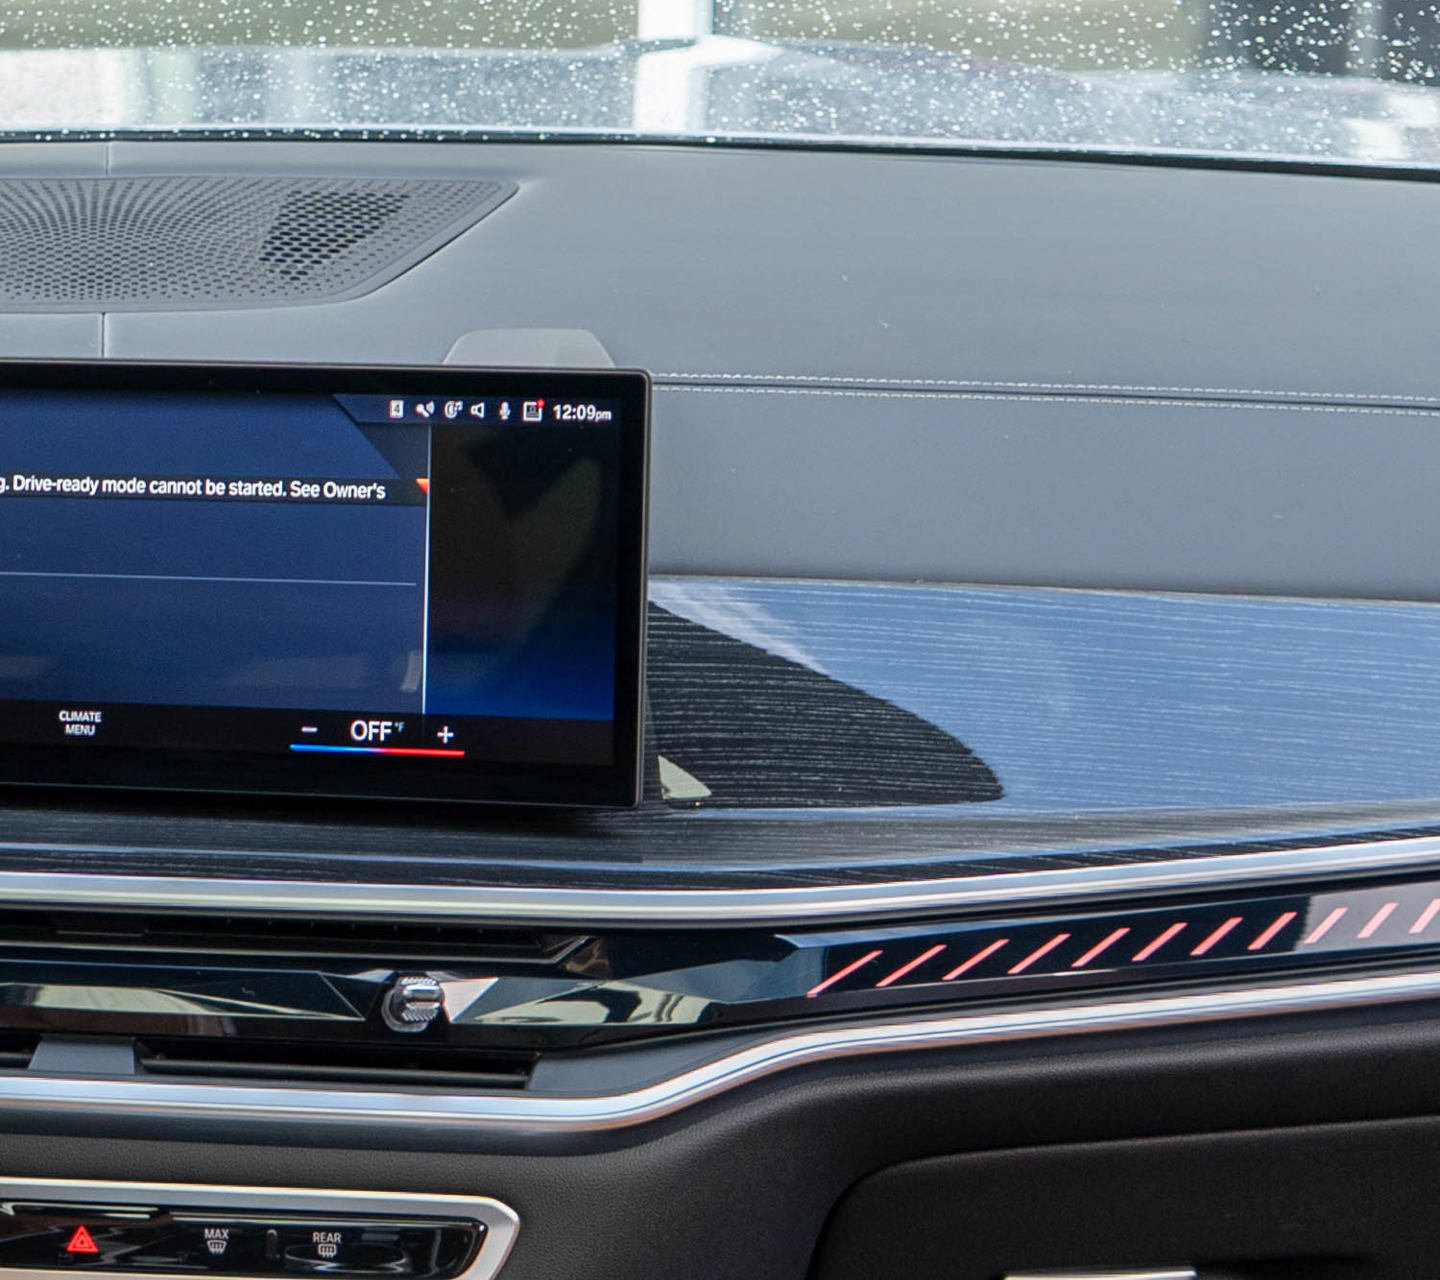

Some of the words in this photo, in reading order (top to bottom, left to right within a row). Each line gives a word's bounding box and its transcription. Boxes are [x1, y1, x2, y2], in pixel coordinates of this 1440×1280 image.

[553, 403, 612, 424] 12:09pm
[12, 474, 99, 496] Drive-ready
[102, 477, 146, 494] mode
[149, 479, 203, 496] cannot
[205, 478, 226, 496] be
[228, 479, 287, 498] started.
[289, 480, 321, 498] See
[323, 480, 386, 500] Owner's
[58, 710, 102, 723] CLIMATE
[64, 723, 96, 737] MENU
[350, 720, 393, 742] OFF
[203, 1227, 230, 1240] MAX
[312, 1231, 342, 1244] REAR
